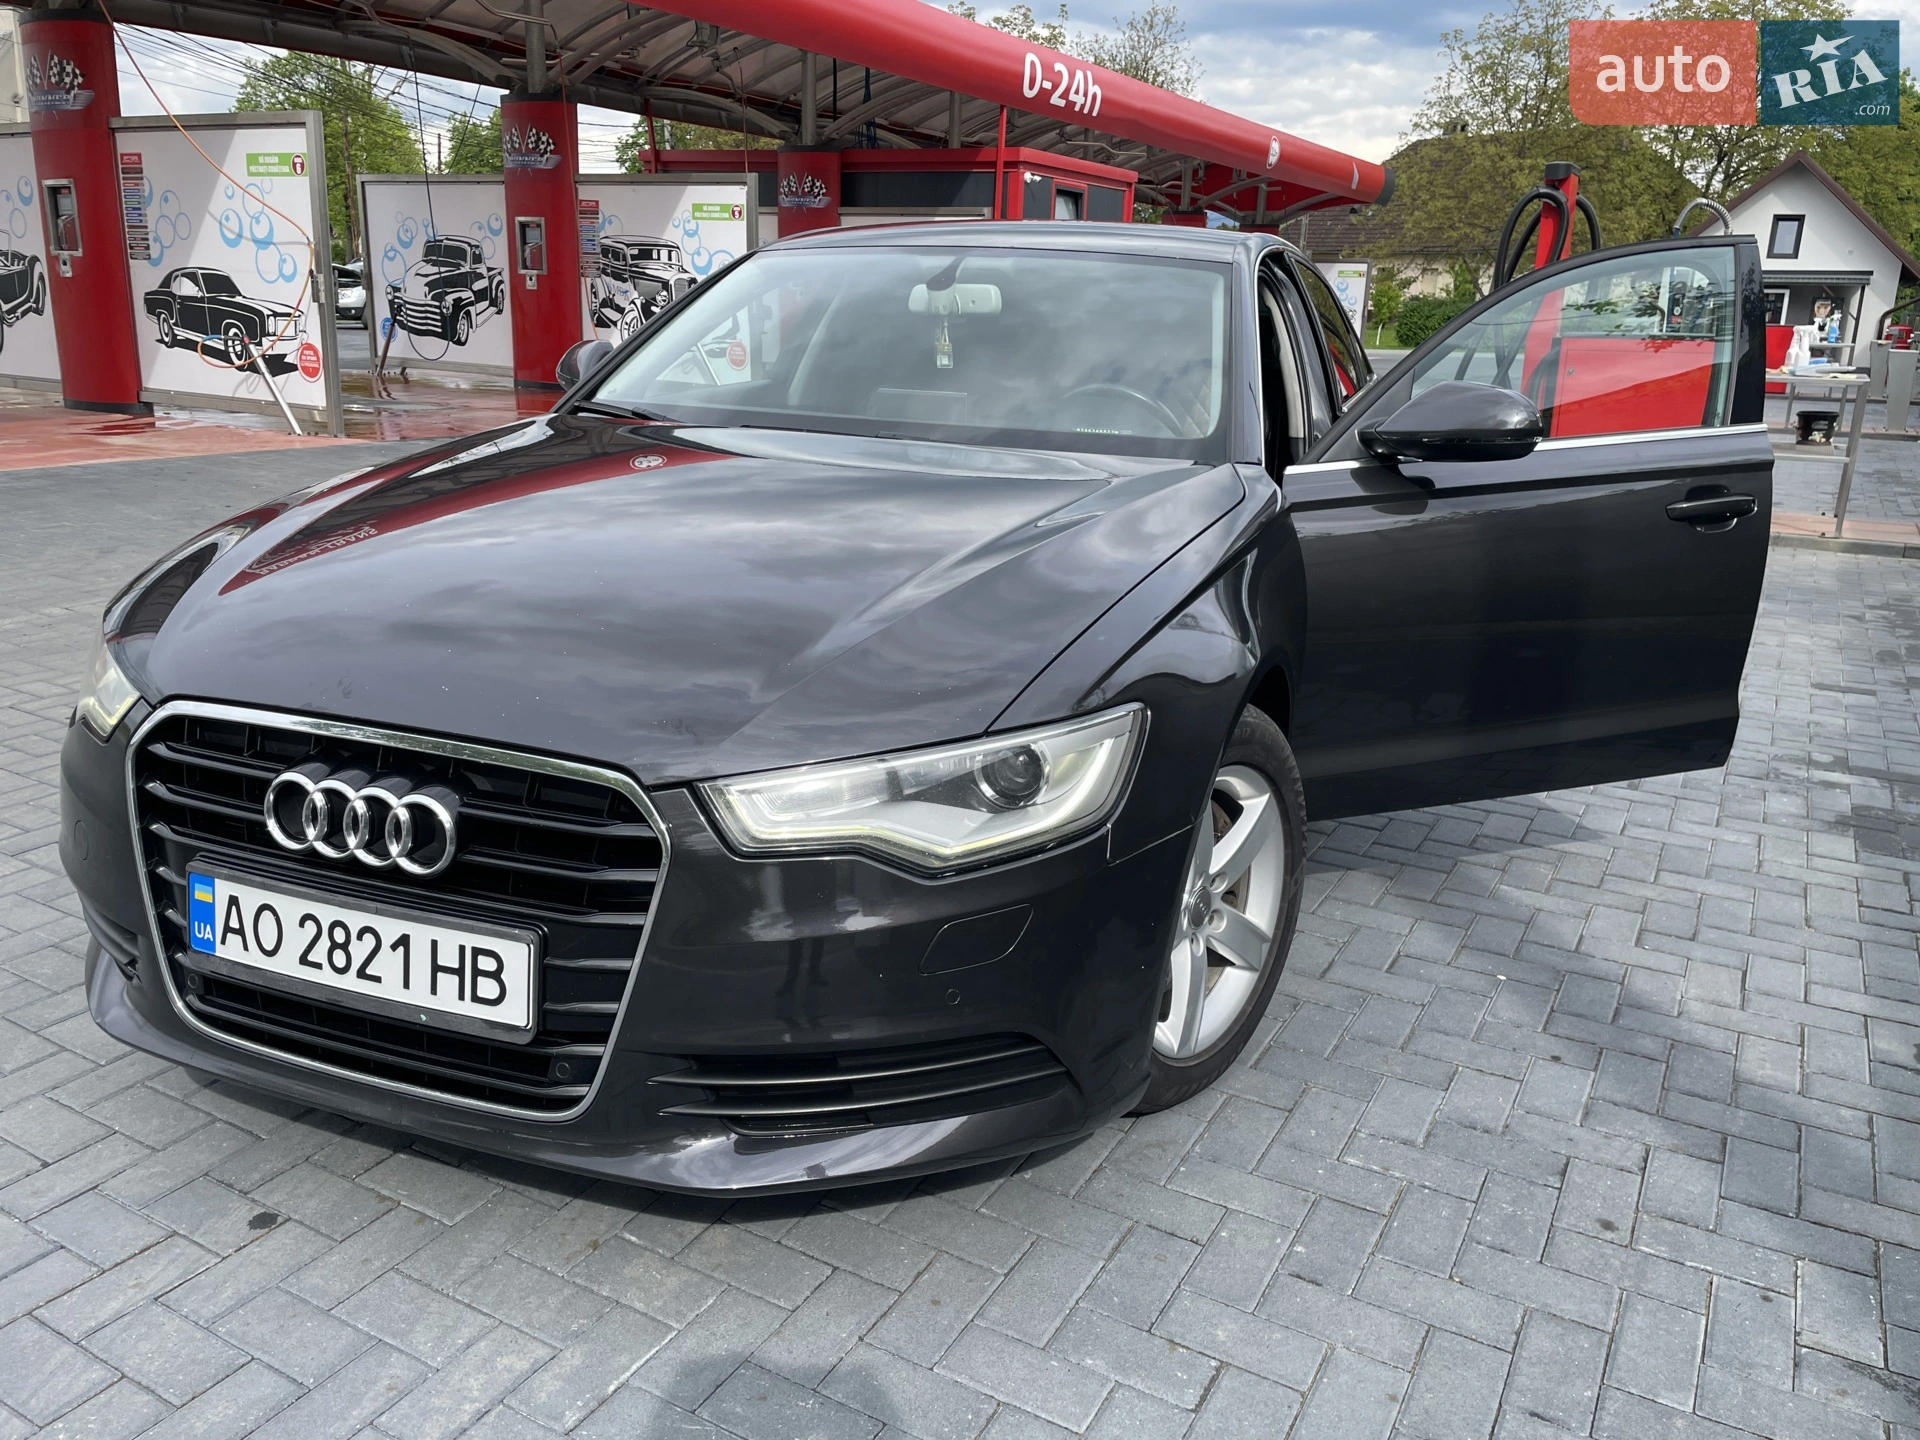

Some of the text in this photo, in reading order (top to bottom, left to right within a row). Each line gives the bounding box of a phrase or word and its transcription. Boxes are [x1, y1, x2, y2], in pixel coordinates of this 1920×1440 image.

[1023, 52, 1102, 117] 0-24h
[295, 163, 302, 174] 6
[194, 921, 214, 942] UA
[220, 894, 507, 1007] AO 2821 HB
